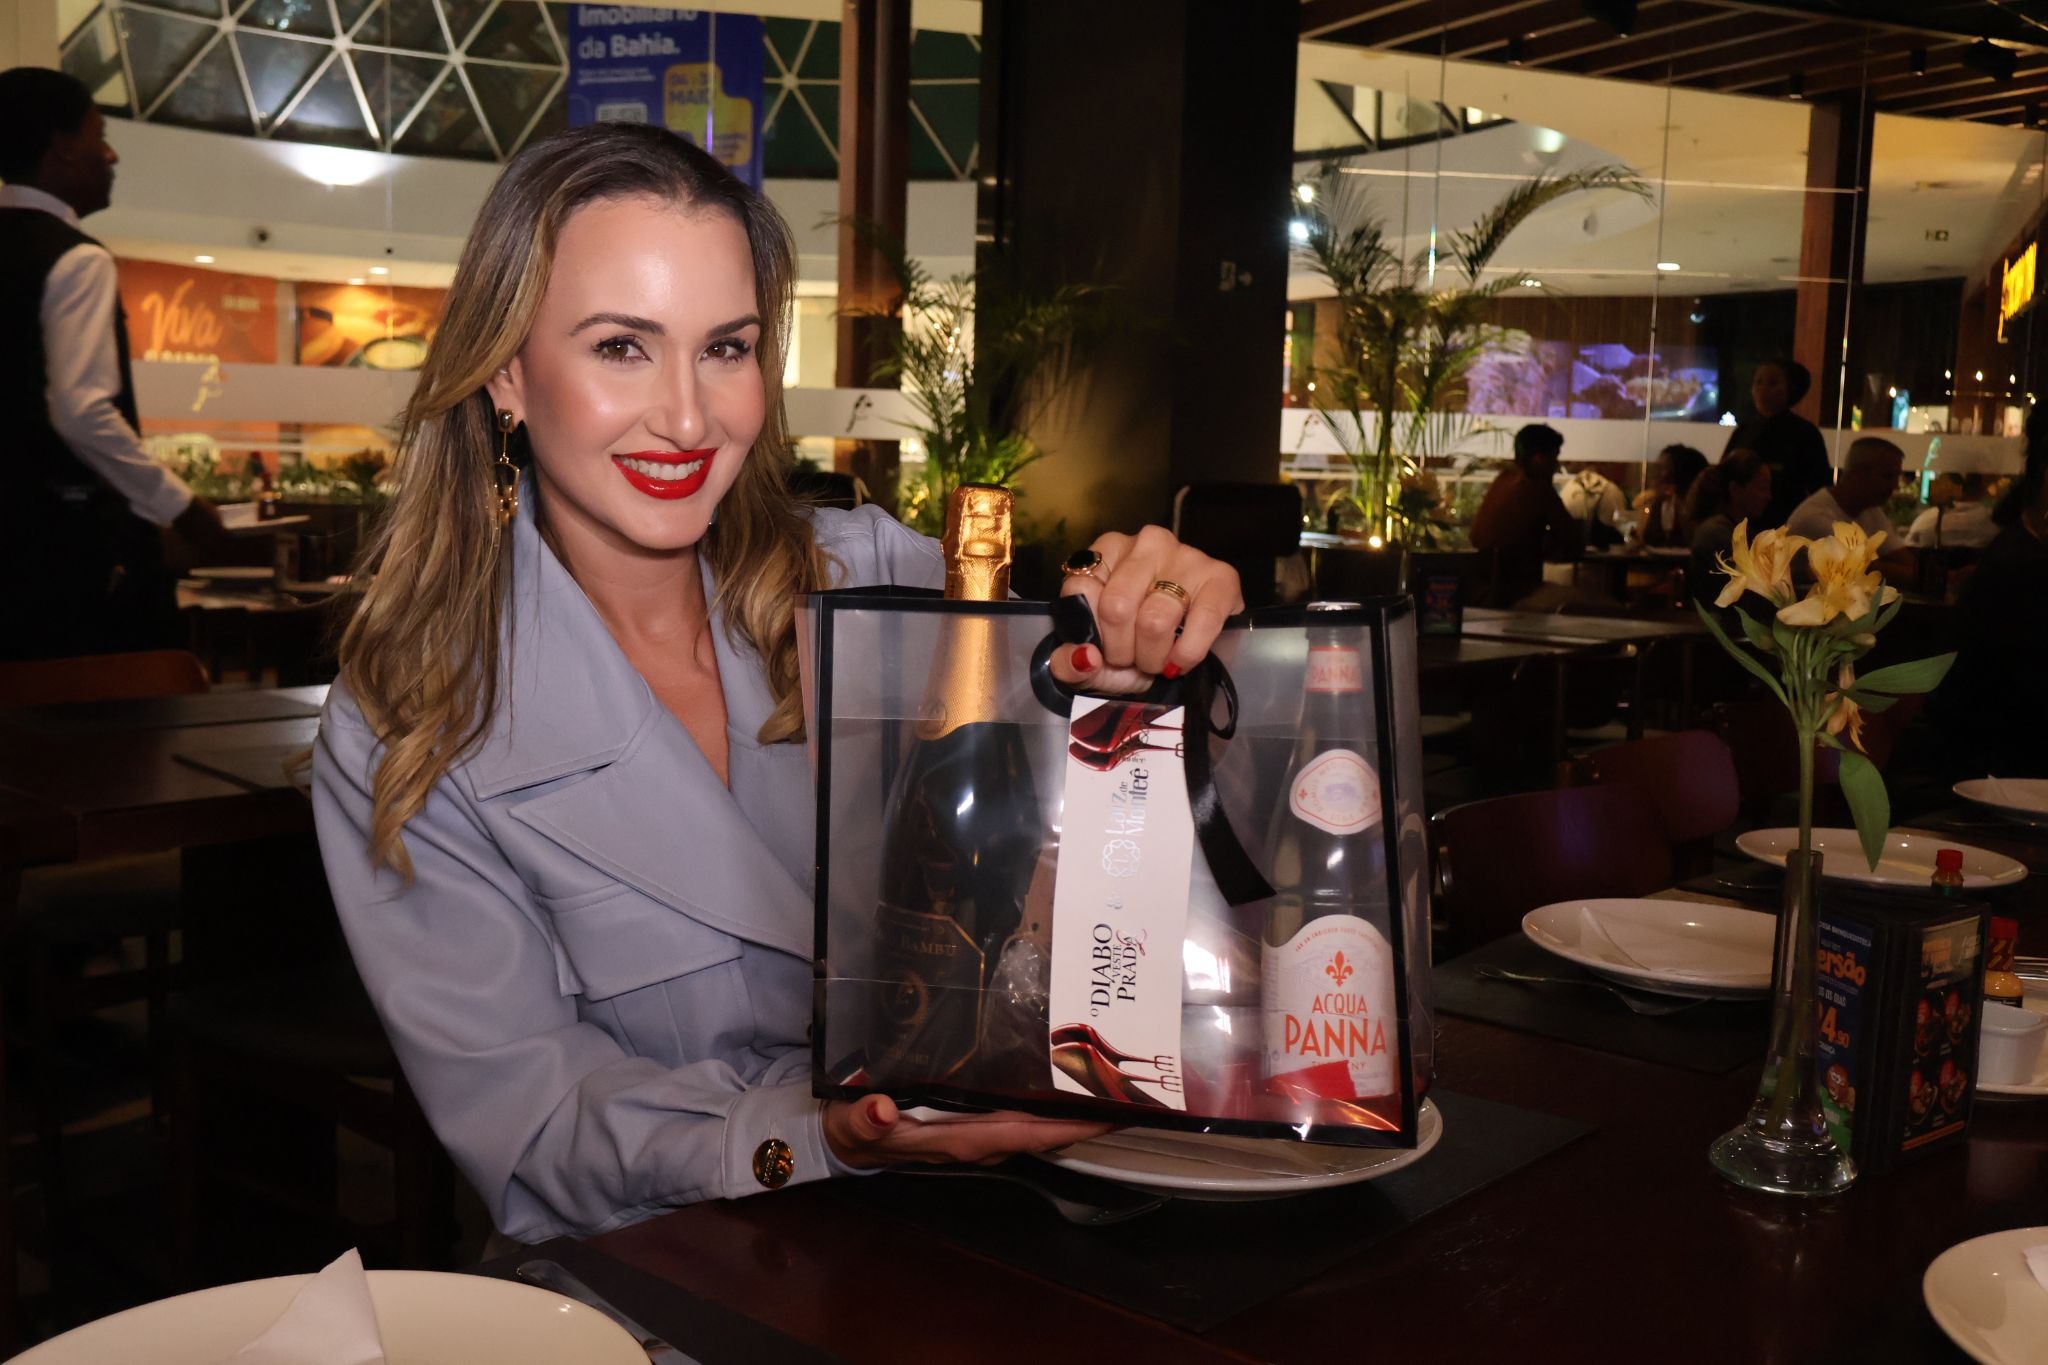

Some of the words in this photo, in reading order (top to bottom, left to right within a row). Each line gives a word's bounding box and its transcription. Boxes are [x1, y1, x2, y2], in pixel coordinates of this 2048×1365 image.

[578, 36, 606, 59] da
[610, 32, 681, 58] Bahia.
[141, 279, 223, 353] Viva
[1119, 781, 1128, 793] de
[1091, 923, 1114, 1008] DIABO
[1112, 944, 1121, 977] VESTE
[1117, 936, 1137, 1001] PRADA
[1818, 949, 1866, 986] ersão
[1311, 993, 1368, 1015] ACQUA
[1285, 1013, 1387, 1057] PANNA
